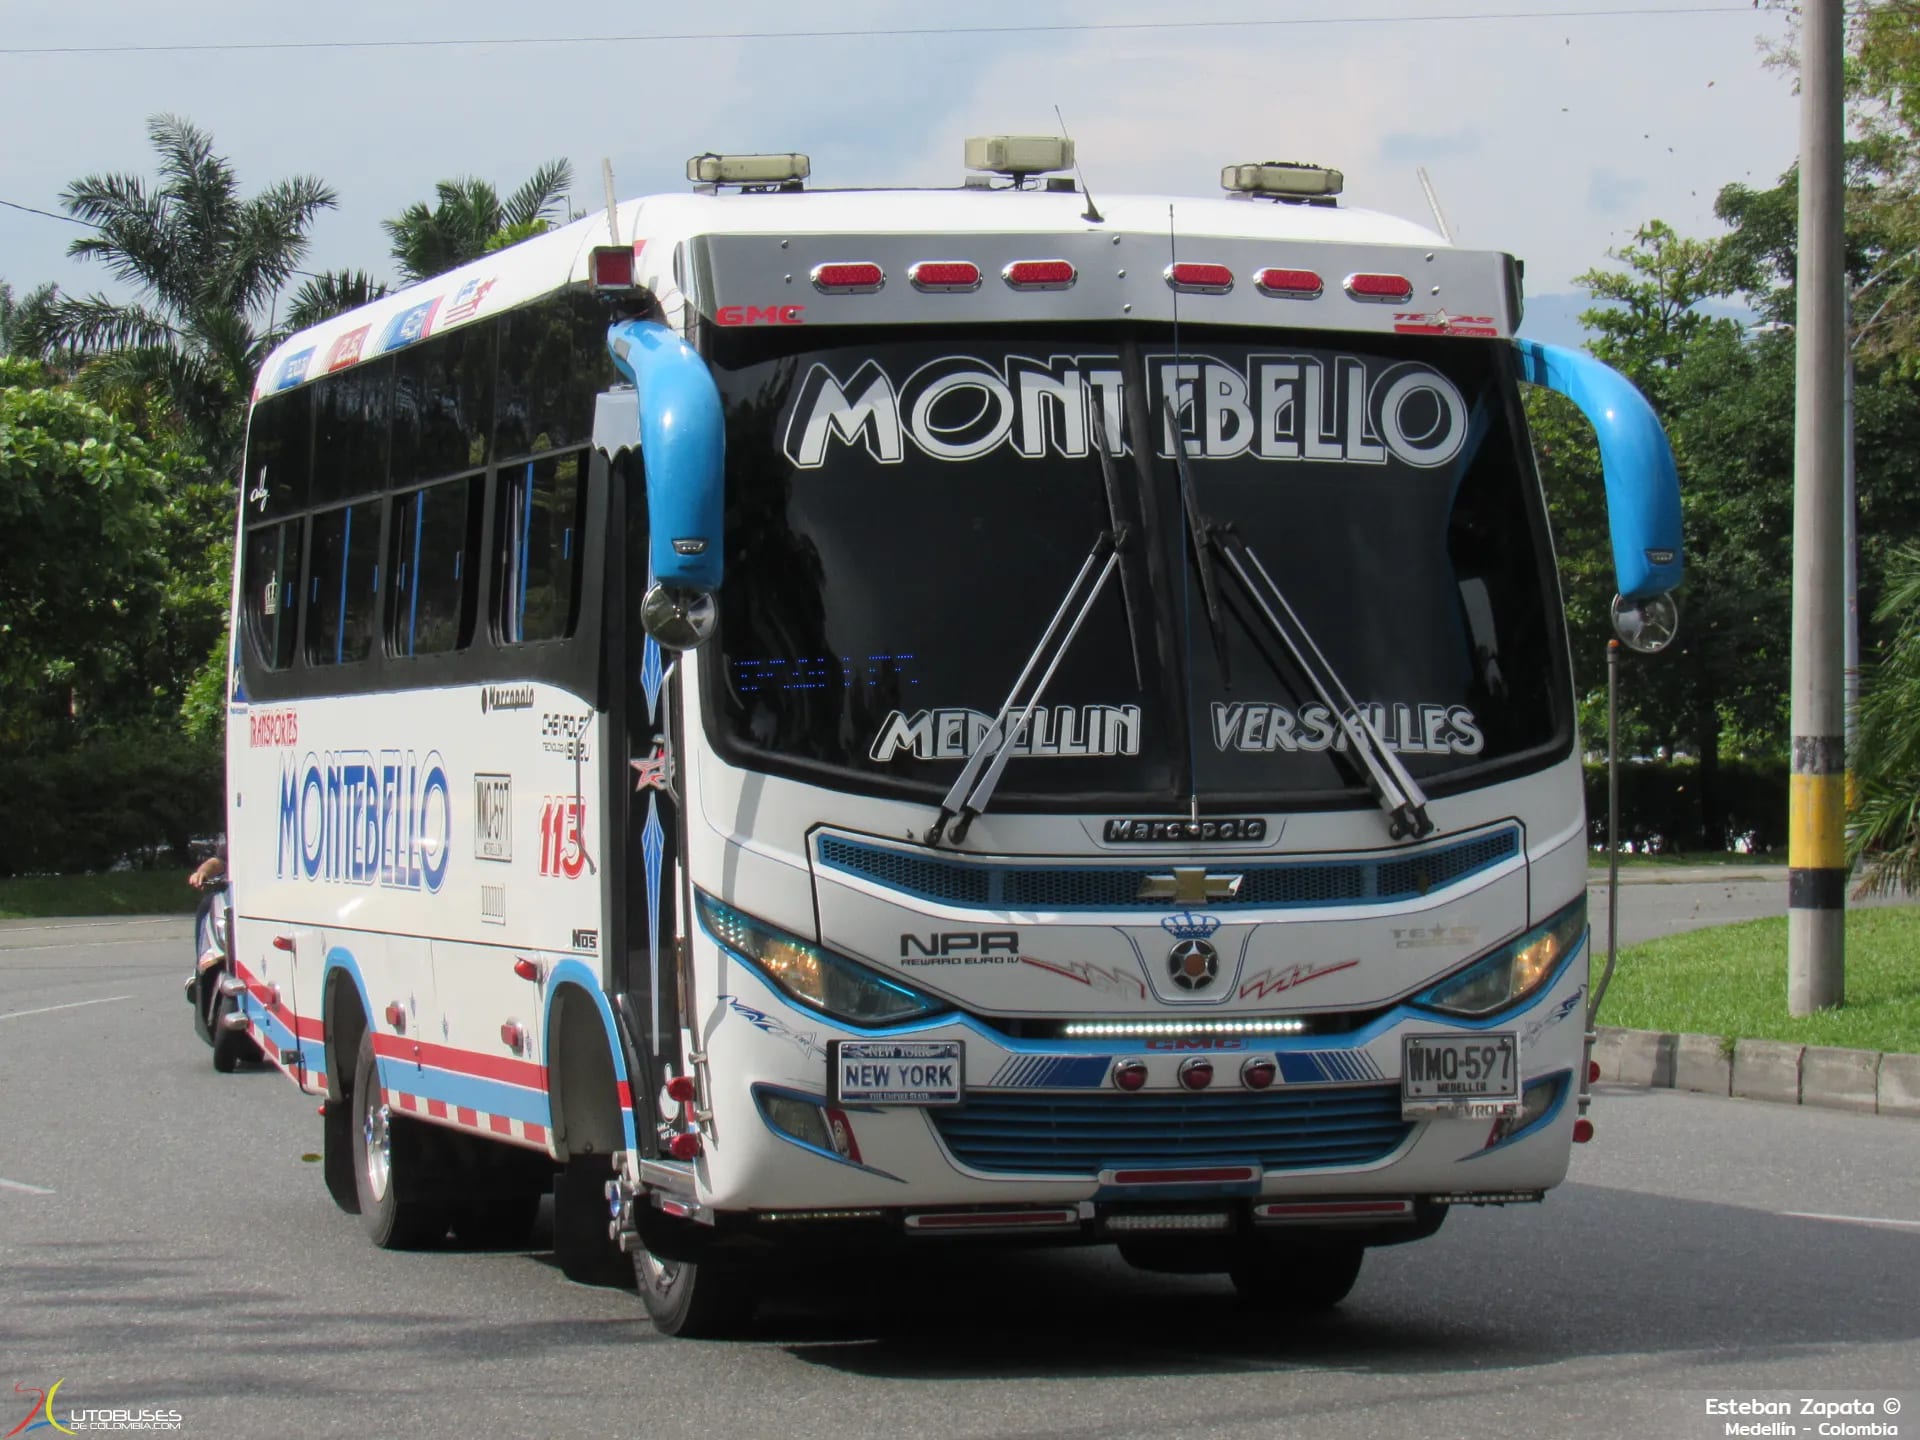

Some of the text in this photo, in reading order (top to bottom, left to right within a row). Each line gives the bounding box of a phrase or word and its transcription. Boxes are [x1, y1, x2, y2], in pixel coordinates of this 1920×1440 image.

[715, 304, 806, 326] GMC
[783, 354, 1468, 468] MONTEBELLO
[489, 685, 534, 711] Marcopolo
[249, 708, 297, 748] TRANSPORTES
[869, 704, 1141, 762] MEDELLIN
[1210, 702, 1485, 755] VERSALLES
[277, 749, 451, 894] MONTEBELLO
[1110, 819, 1262, 841] Marcpolo
[539, 795, 586, 879] 113
[572, 928, 598, 949] NOS
[900, 931, 1019, 956] NPR
[901, 958, 961, 966] REWARD
[964, 957, 1004, 965] EURO
[845, 1064, 953, 1087] NEW YORK
